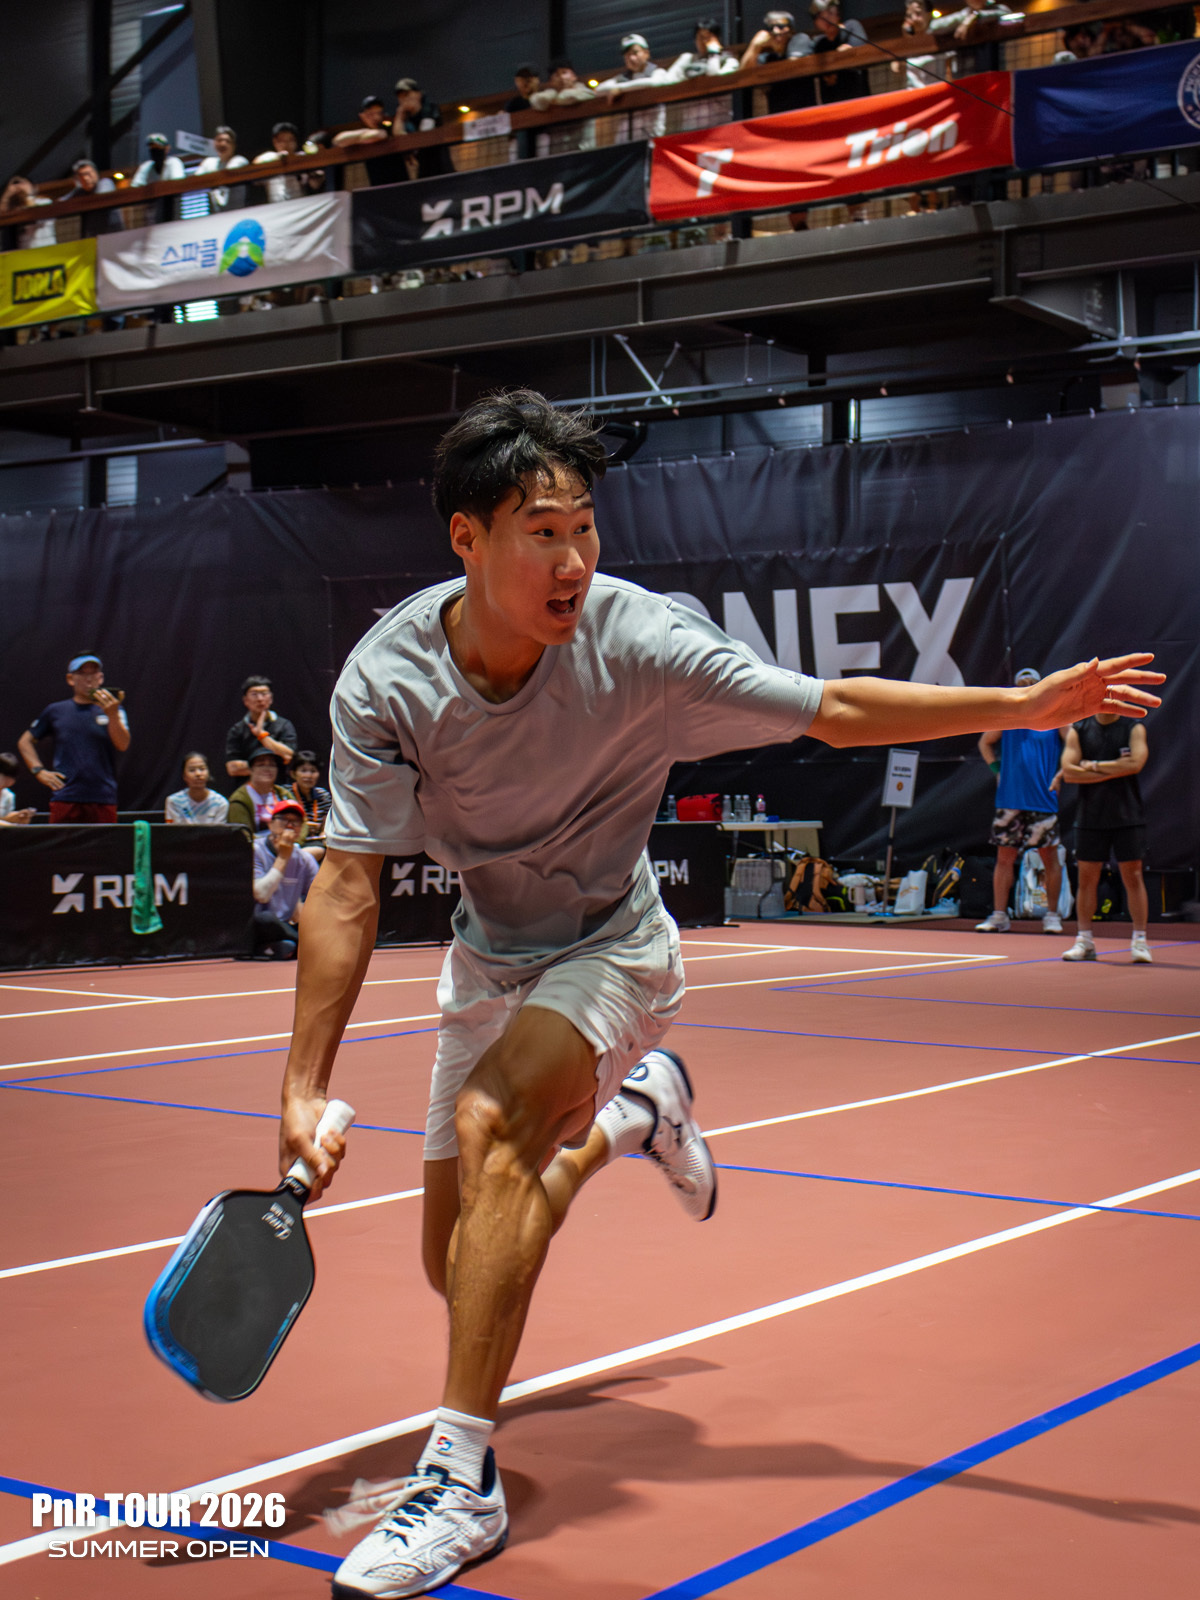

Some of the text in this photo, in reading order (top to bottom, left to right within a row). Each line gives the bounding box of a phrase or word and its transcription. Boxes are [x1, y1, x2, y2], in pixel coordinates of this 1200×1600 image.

[845, 120, 958, 168] Trion
[461, 182, 564, 231] RPM
[161, 238, 218, 268] 스파클
[670, 577, 975, 687] NEX
[653, 859, 689, 886] PM
